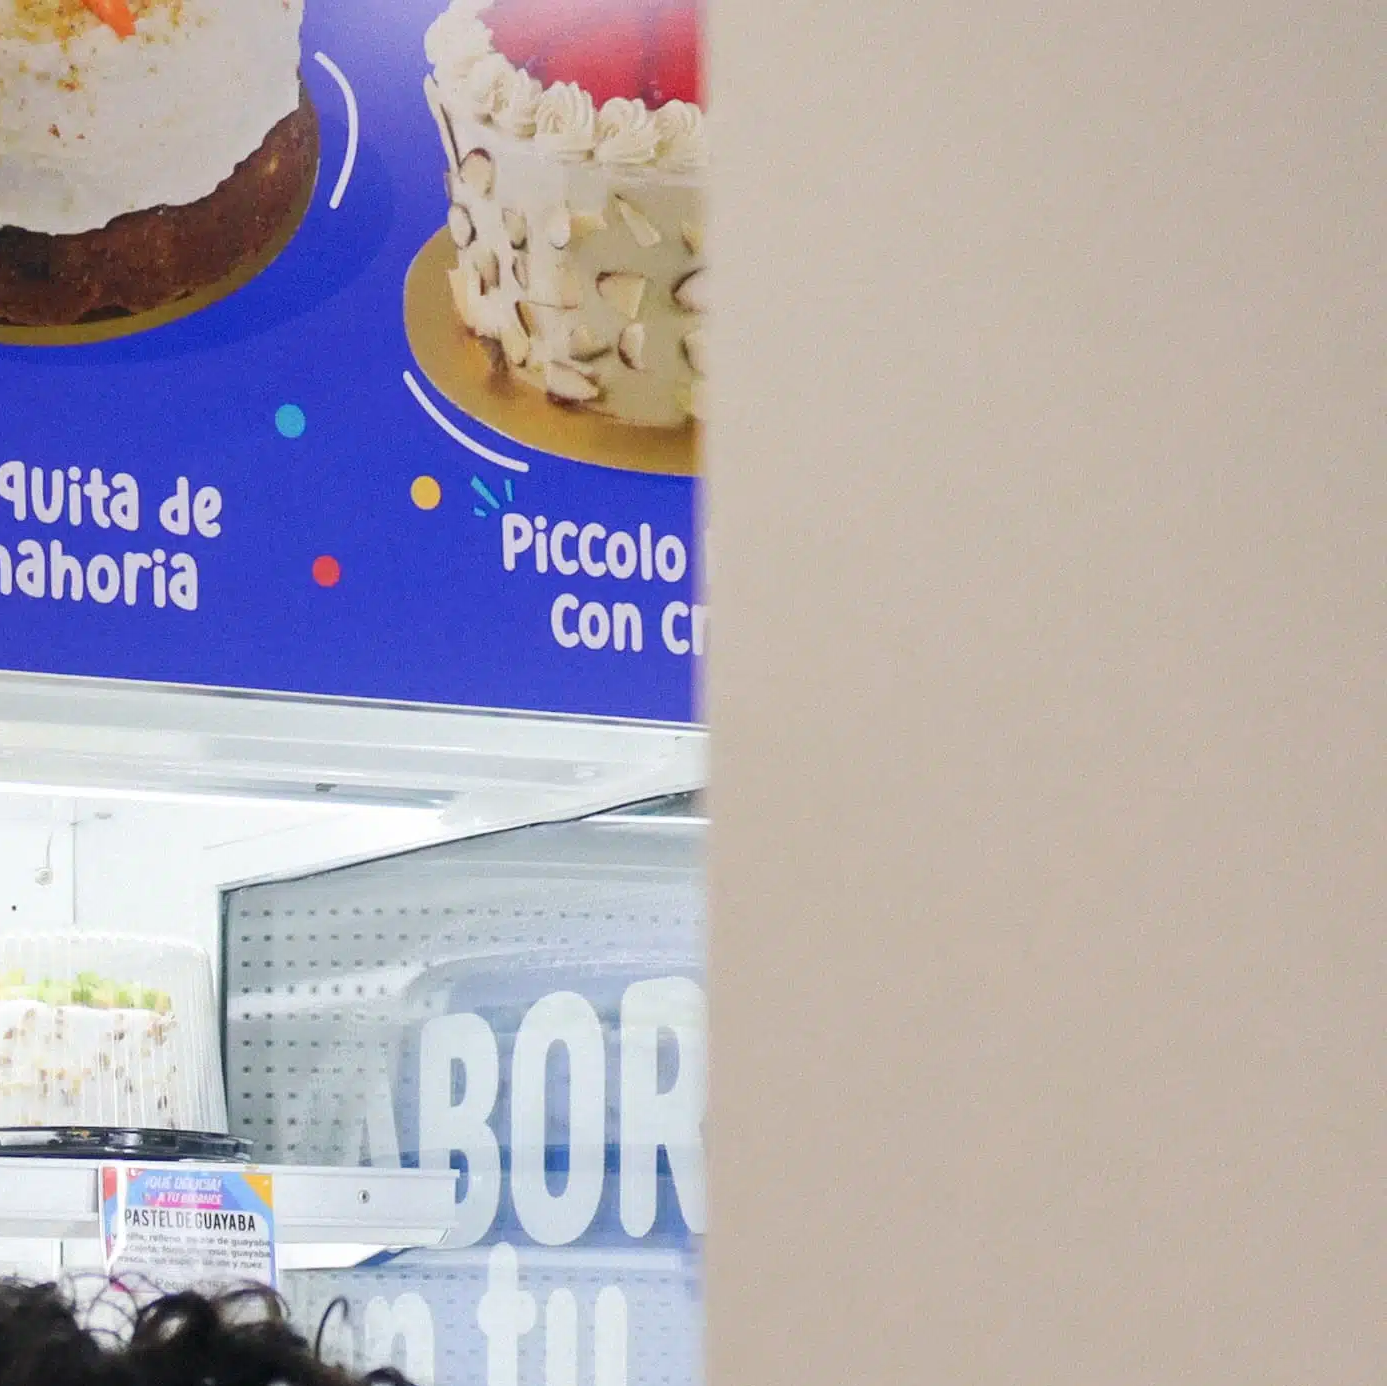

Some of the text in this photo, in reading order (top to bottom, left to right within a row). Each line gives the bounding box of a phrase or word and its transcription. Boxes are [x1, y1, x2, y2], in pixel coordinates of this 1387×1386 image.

[159, 475, 223, 539] de
[502, 512, 686, 583] Piccolo
[124, 1209, 256, 1231] PASTEL DE GUAYABA
